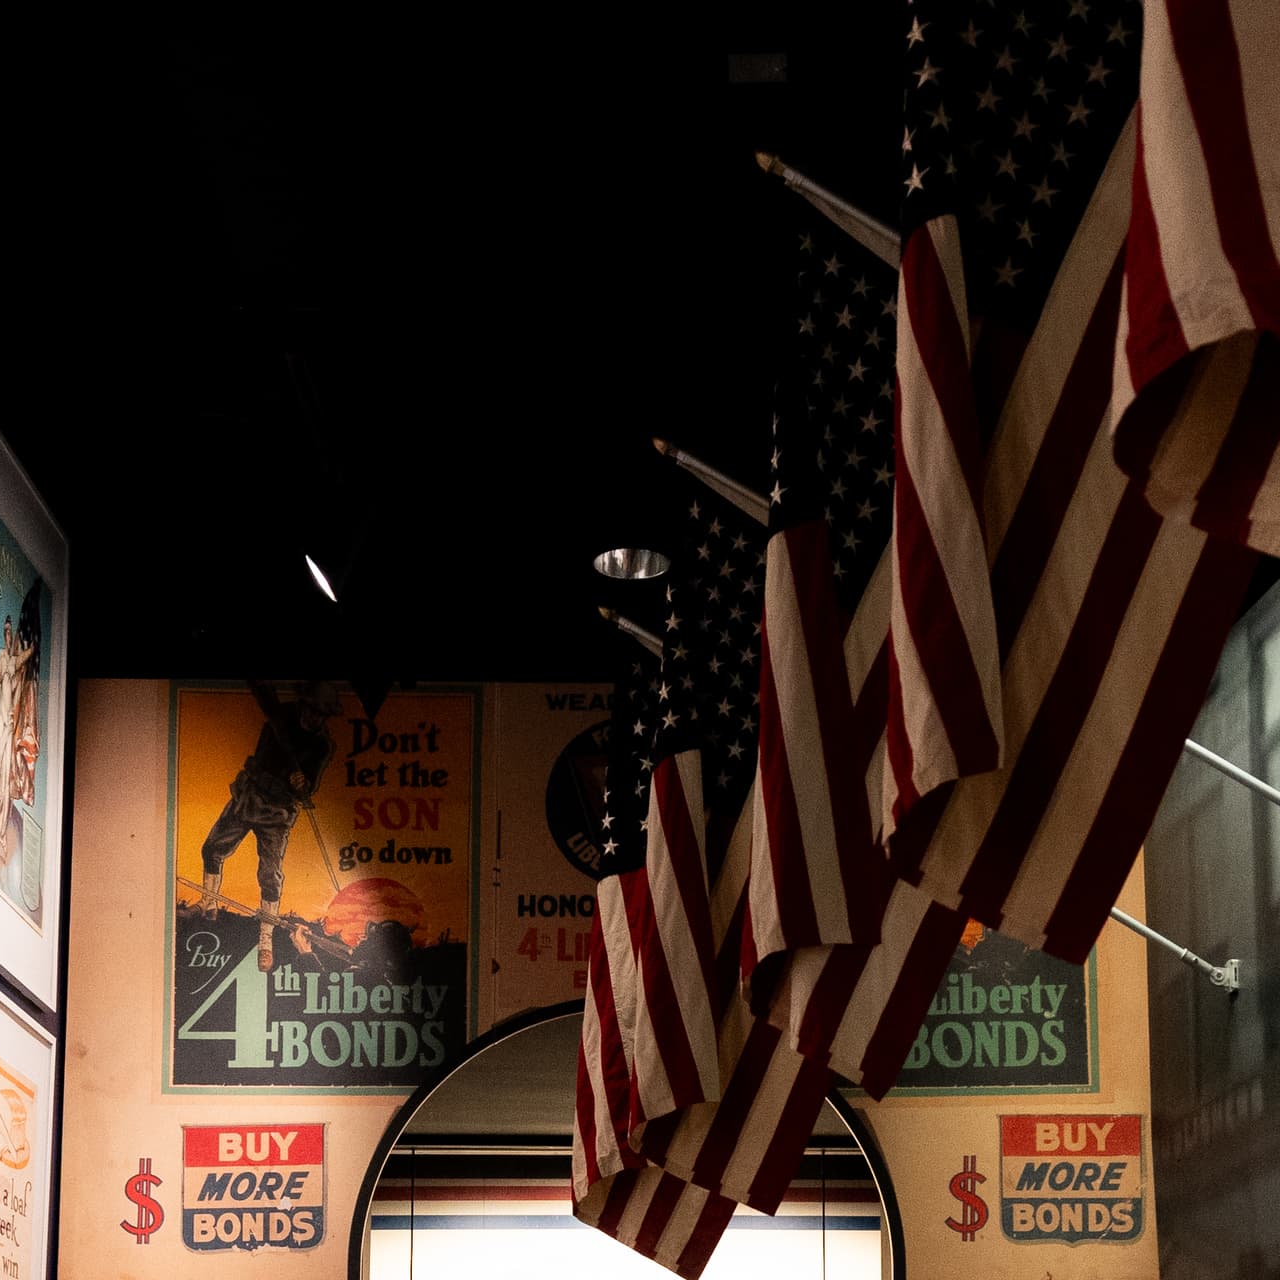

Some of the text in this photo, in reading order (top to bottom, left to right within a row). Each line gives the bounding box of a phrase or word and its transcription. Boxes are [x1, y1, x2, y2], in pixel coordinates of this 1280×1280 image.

[346, 717, 440, 758] Don't
[344, 760, 449, 789] let the
[353, 797, 441, 832] SON
[338, 839, 453, 872] go down
[185, 931, 232, 995] Buy
[302, 972, 449, 1019] Liberty
[278, 1020, 447, 1069] BONDS
[901, 1020, 1067, 1070] BONDS
[217, 1131, 299, 1162] BUY
[1033, 1122, 1117, 1152] BUY
[196, 1170, 310, 1202] MORE
[1015, 1162, 1128, 1192] MORE
[3, 1188, 9, 1207] a
[10, 1178, 33, 1218] loaf
[192, 1211, 317, 1245] BONDS
[1011, 1202, 1136, 1234] BONDS
[1, 1252, 19, 1280] win
